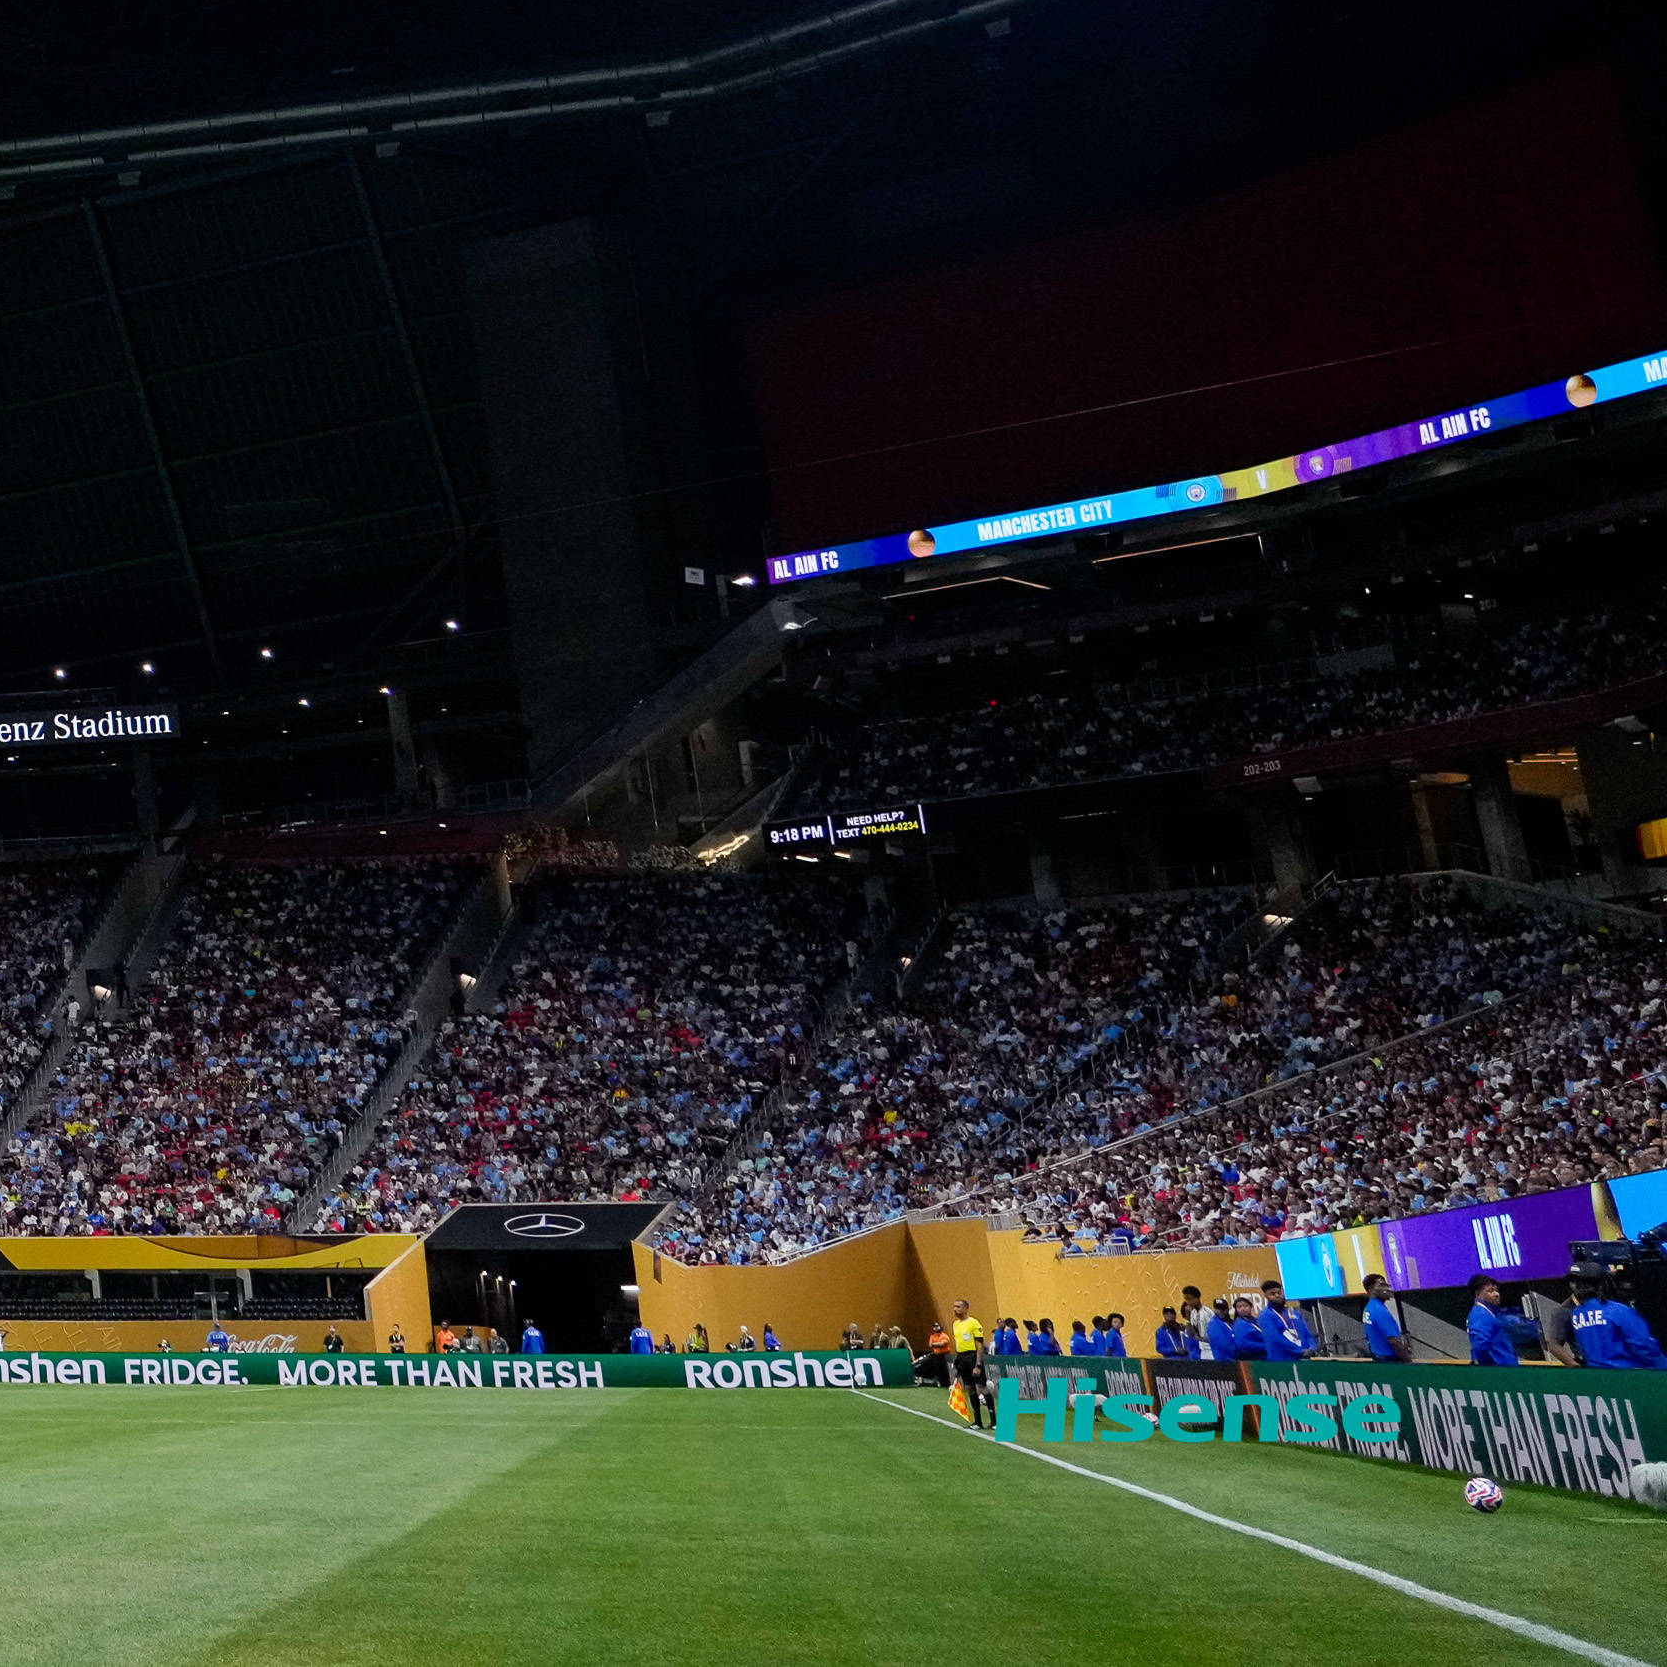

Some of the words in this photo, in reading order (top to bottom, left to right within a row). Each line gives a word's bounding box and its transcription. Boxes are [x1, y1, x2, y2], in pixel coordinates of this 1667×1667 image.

[773, 560, 792, 580] AL
[794, 553, 820, 575] AIN
[821, 550, 840, 571] FC
[977, 506, 1077, 542] MANCHESTER
[1079, 500, 1113, 524] CITY
[1419, 423, 1439, 446] AL
[1441, 415, 1469, 441] AIN
[1469, 407, 1492, 432] FC
[54, 709, 173, 740] Stadium
[770, 828, 800, 843] 9:18
[801, 825, 824, 839] PM
[835, 827, 861, 839] TEXT
[846, 813, 873, 827] NEED
[873, 811, 905, 824] HELP?
[278, 1359, 379, 1387] MORE
[385, 1360, 489, 1388] THAN
[493, 1359, 605, 1390] FRESH
[683, 1351, 884, 1389] Ronshen
[994, 1376, 1402, 1443] Hisense
[1407, 1384, 1485, 1474] MORE
[1467, 1389, 1559, 1489] THAN
[1543, 1392, 1648, 1502] FRESH
